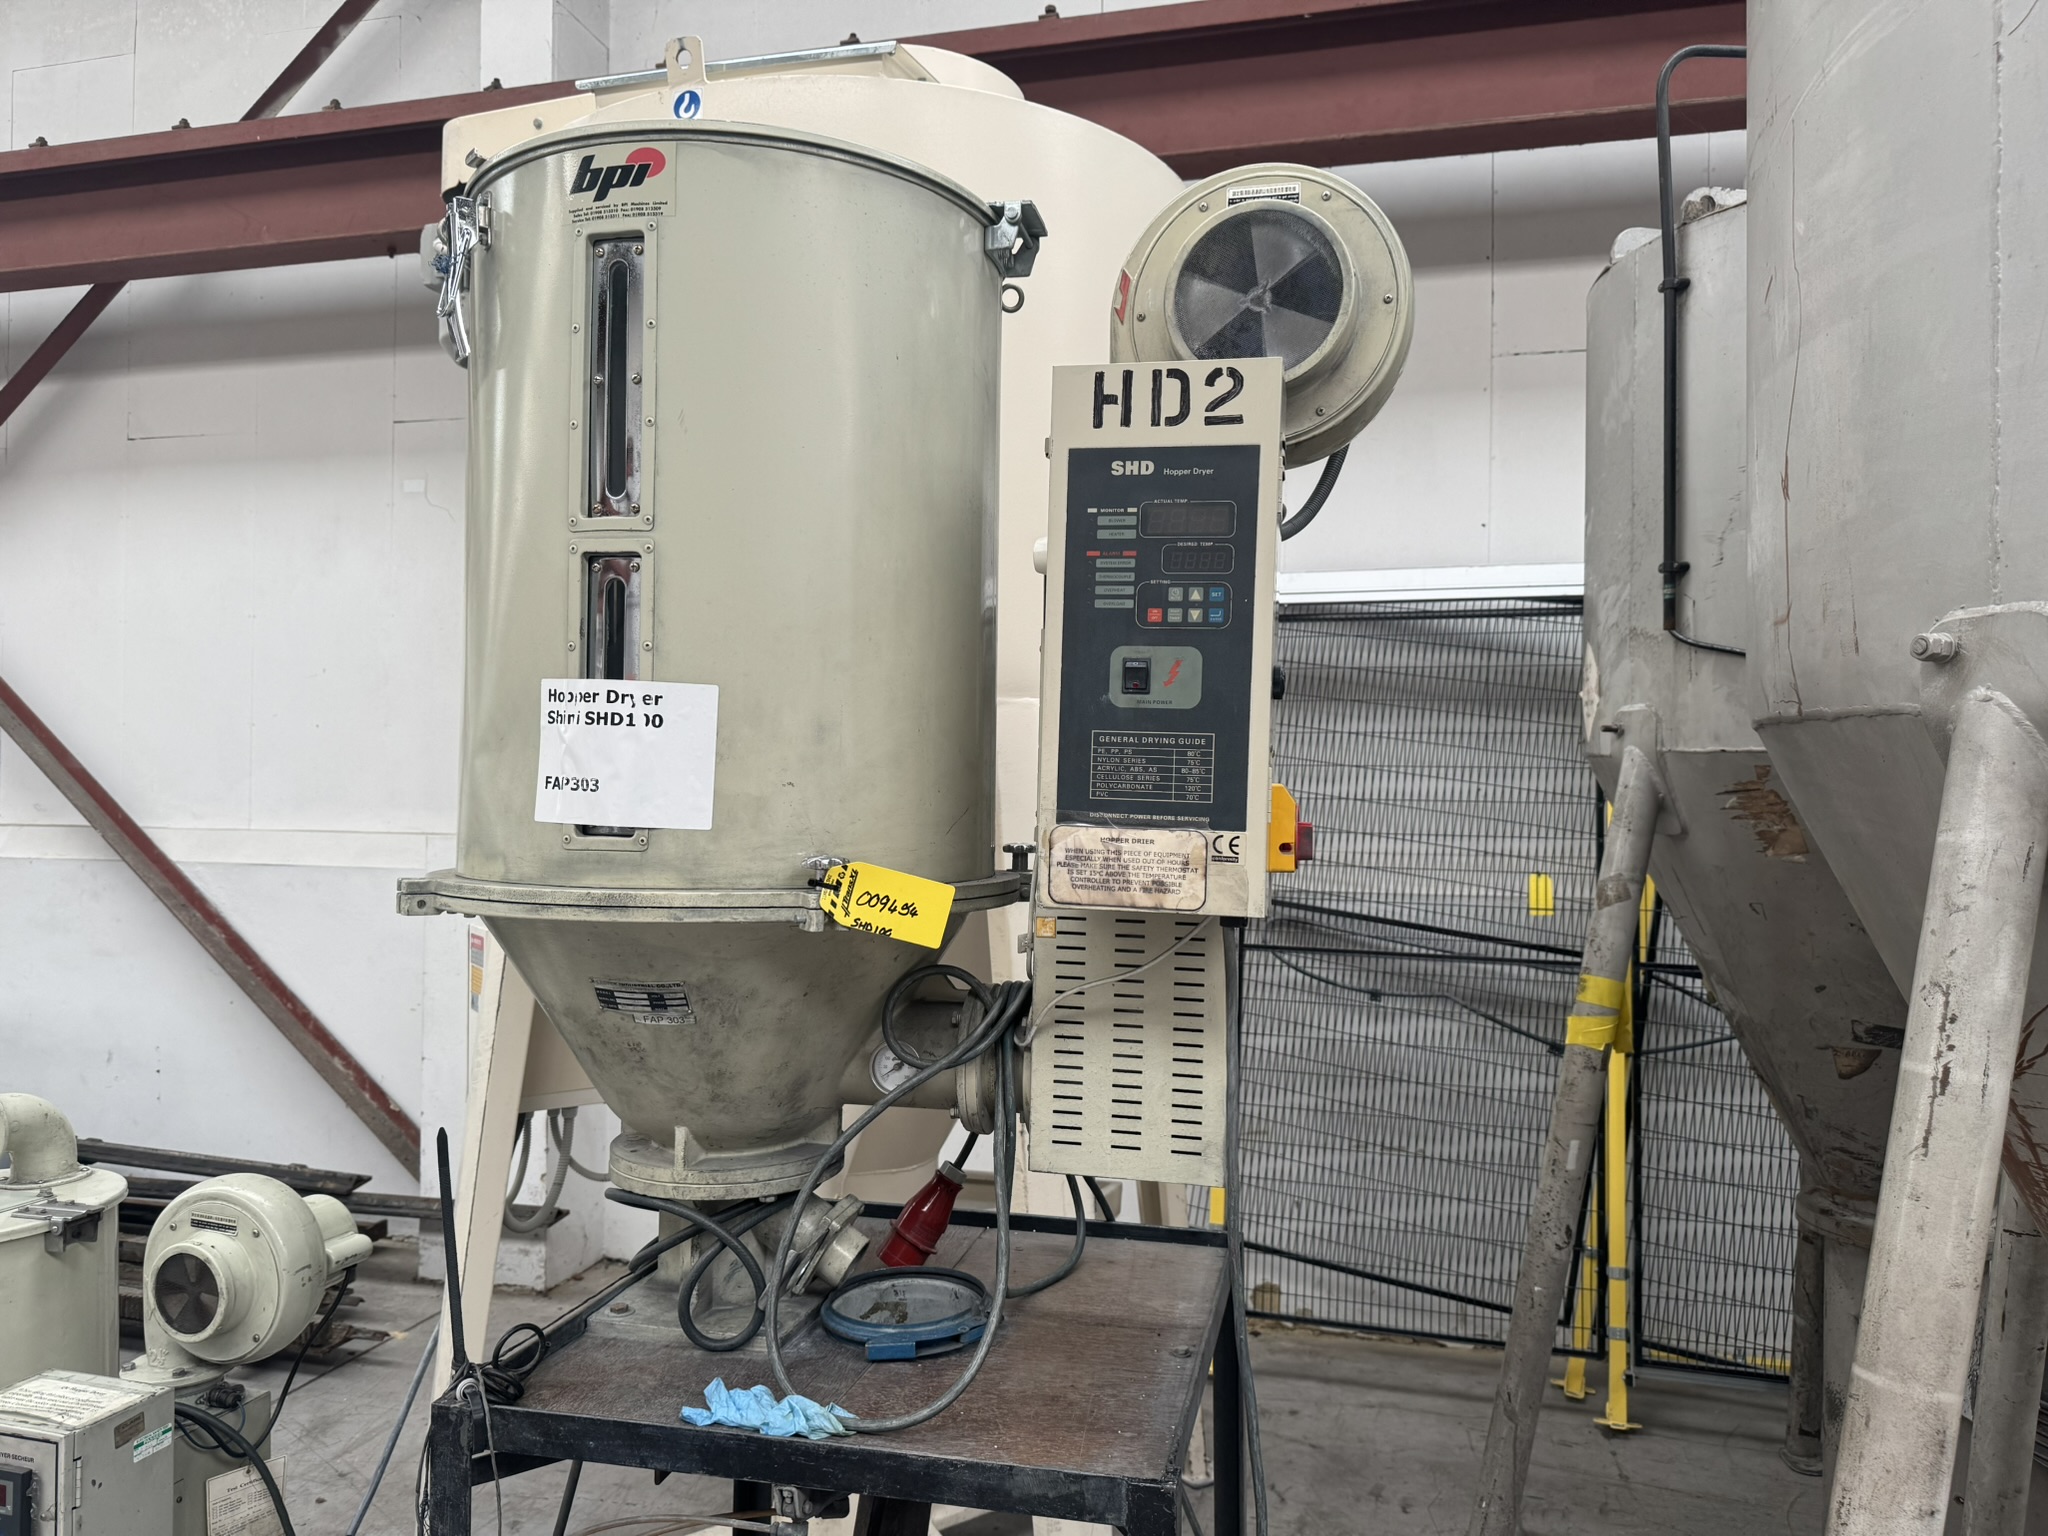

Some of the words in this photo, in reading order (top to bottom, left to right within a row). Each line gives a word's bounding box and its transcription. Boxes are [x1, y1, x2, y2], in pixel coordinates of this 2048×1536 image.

[570, 154, 652, 203] bpi
[1093, 367, 1244, 428] HD2
[1111, 460, 1155, 476] SHD
[1163, 468, 1191, 477] Hopper
[1193, 467, 1214, 477] Dryer
[606, 689, 664, 708] Dryer
[547, 710, 581, 725] Shini
[1099, 735, 1139, 743] GENERAL
[1141, 736, 1176, 745] DRYING
[1178, 737, 1206, 745] GUIDE
[544, 775, 600, 793] FAP303
[1177, 815, 1210, 823] SERVICING
[1213, 835, 1240, 855] CE
[1131, 864, 1155, 872] SAFETY
[1156, 866, 1199, 874] THERMOSTAT
[1070, 876, 1110, 885] CONTROLLER
[1071, 883, 1116, 892] OVERHEATING
[643, 1016, 664, 1024] FAP
[667, 1016, 686, 1024] 303
